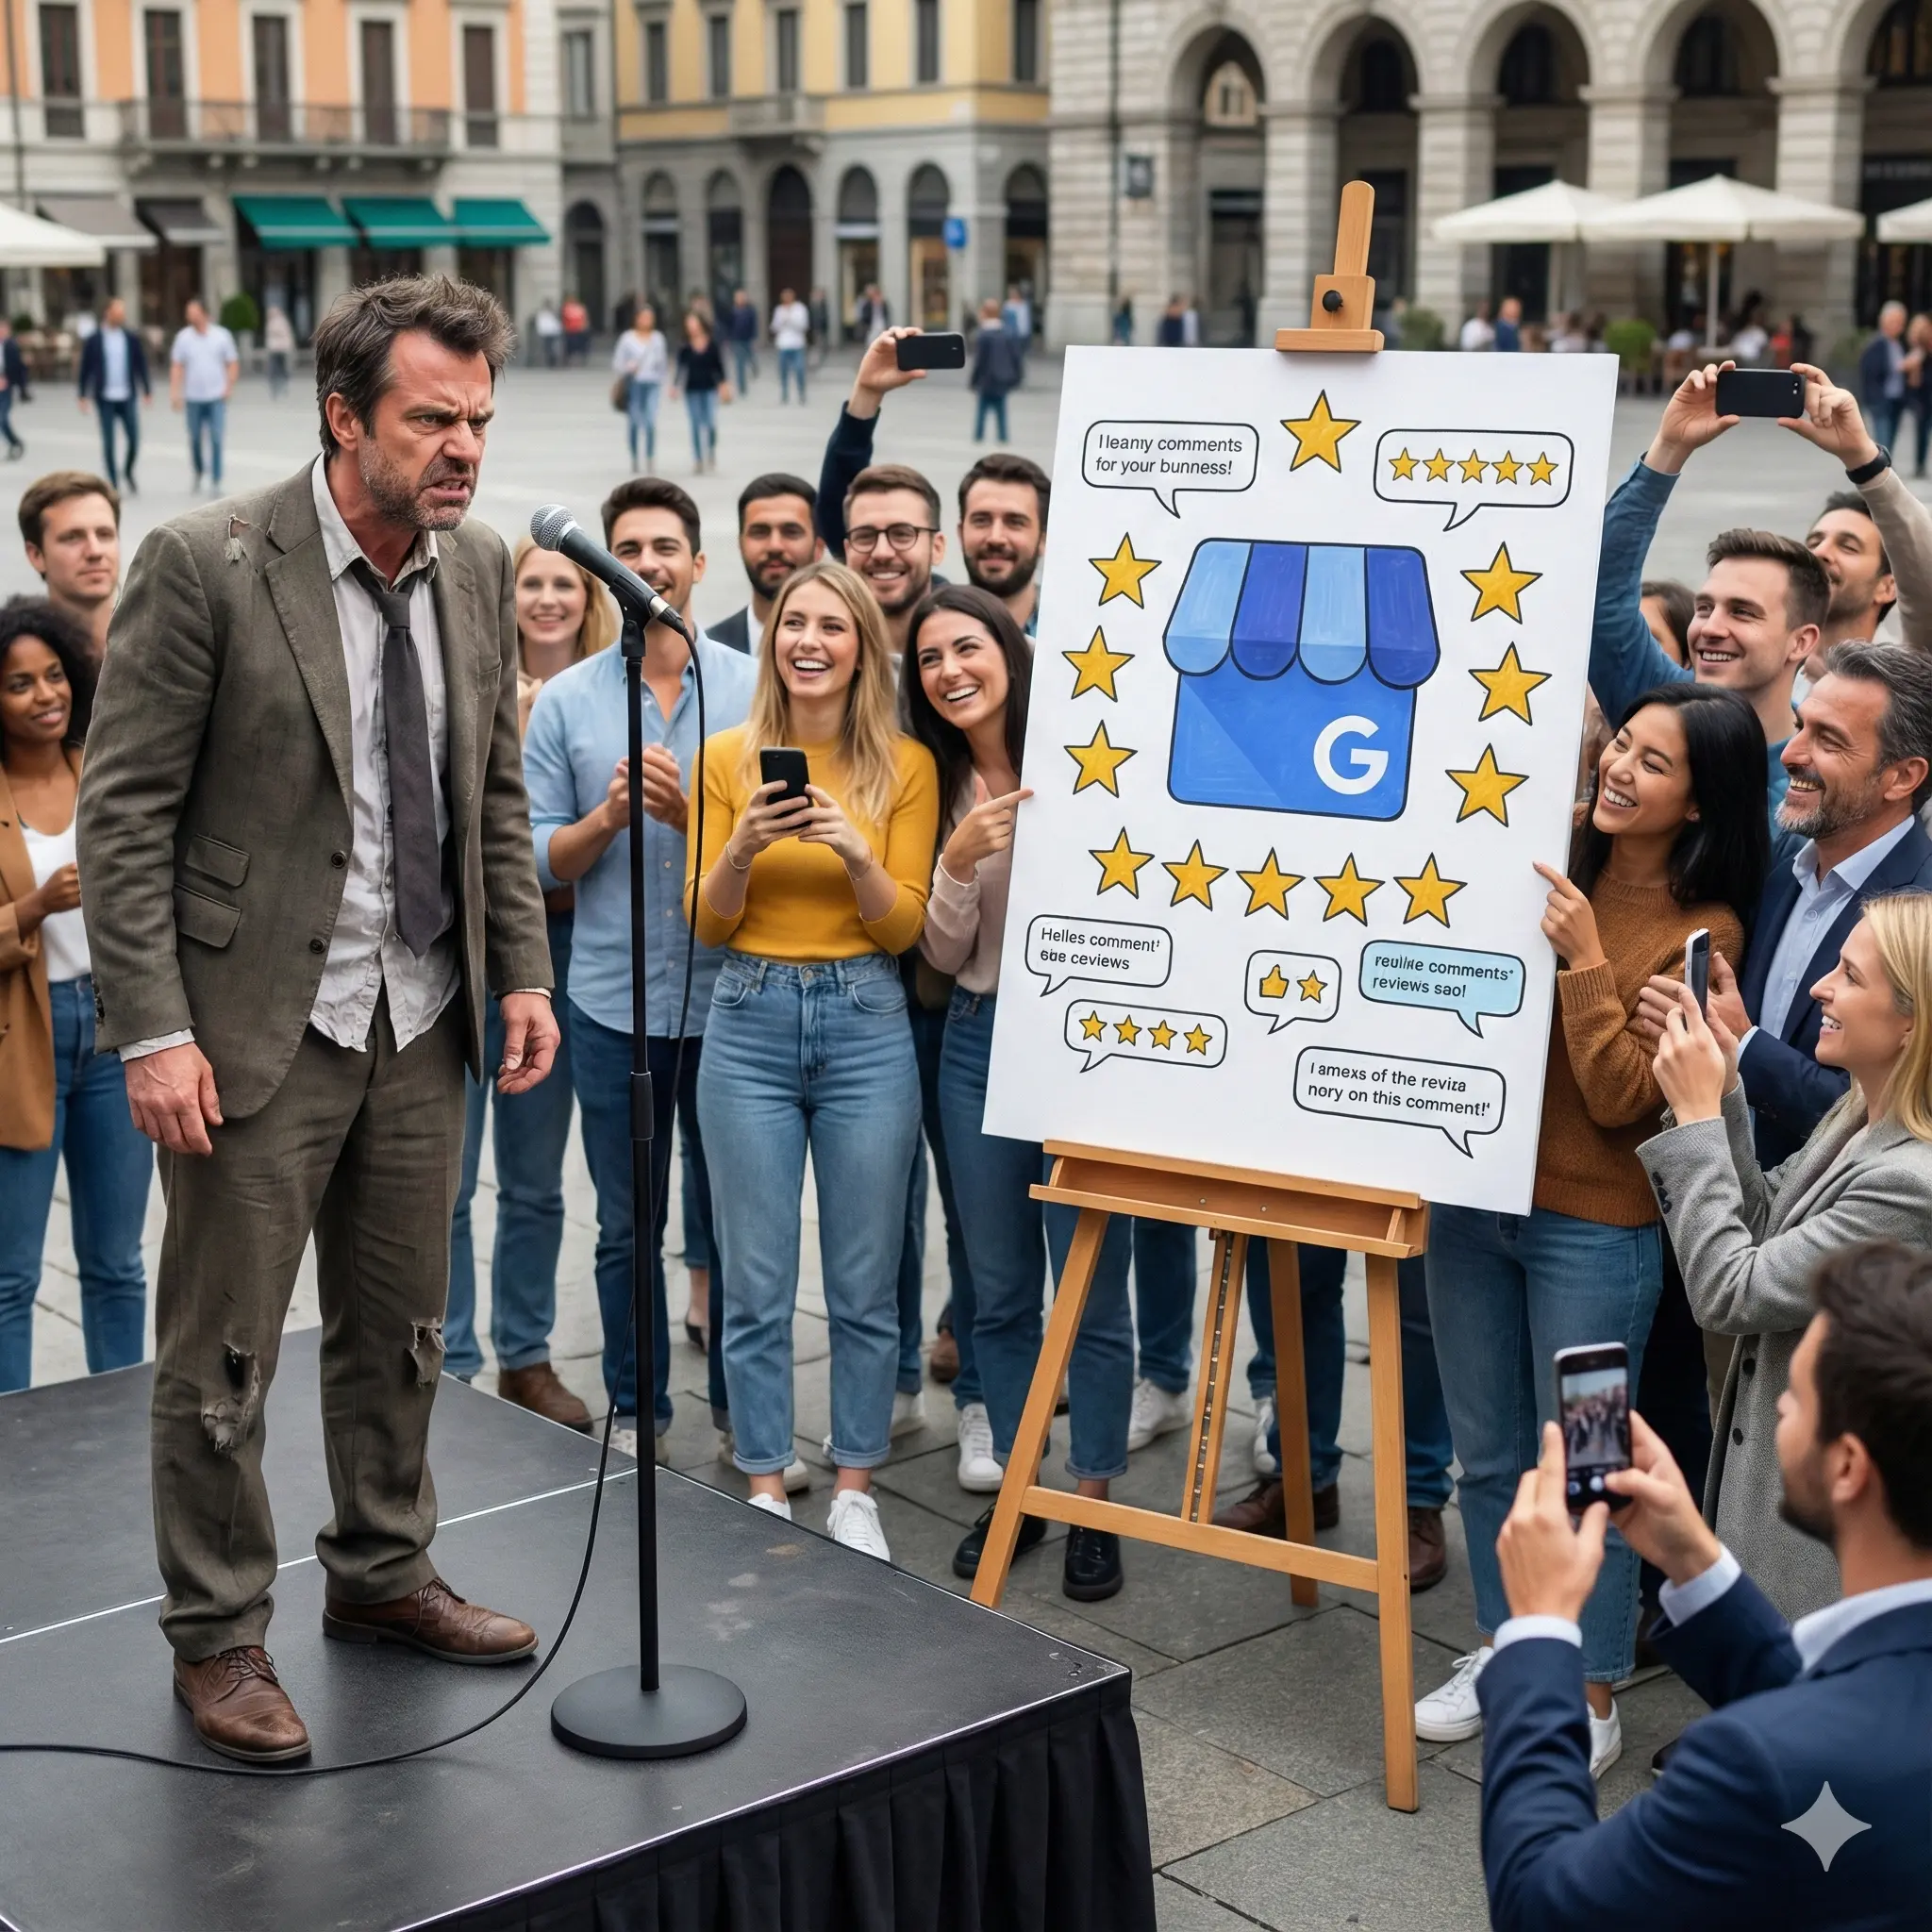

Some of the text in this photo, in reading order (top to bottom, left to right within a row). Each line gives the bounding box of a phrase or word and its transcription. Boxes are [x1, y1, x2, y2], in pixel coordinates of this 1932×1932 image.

[1158, 438, 1242, 453] comments
[1095, 457, 1233, 475] for your bunness!
[1313, 715, 1389, 795] G
[1041, 927, 1085, 944] Helles
[1071, 954, 1130, 970] ceviews
[1373, 976, 1429, 993] reviews
[1318, 1064, 1367, 1080] amexs
[1371, 1069, 1389, 1082] of
[1391, 1071, 1416, 1086] the
[1348, 1090, 1368, 1102] on
[1373, 1091, 1401, 1106] this
